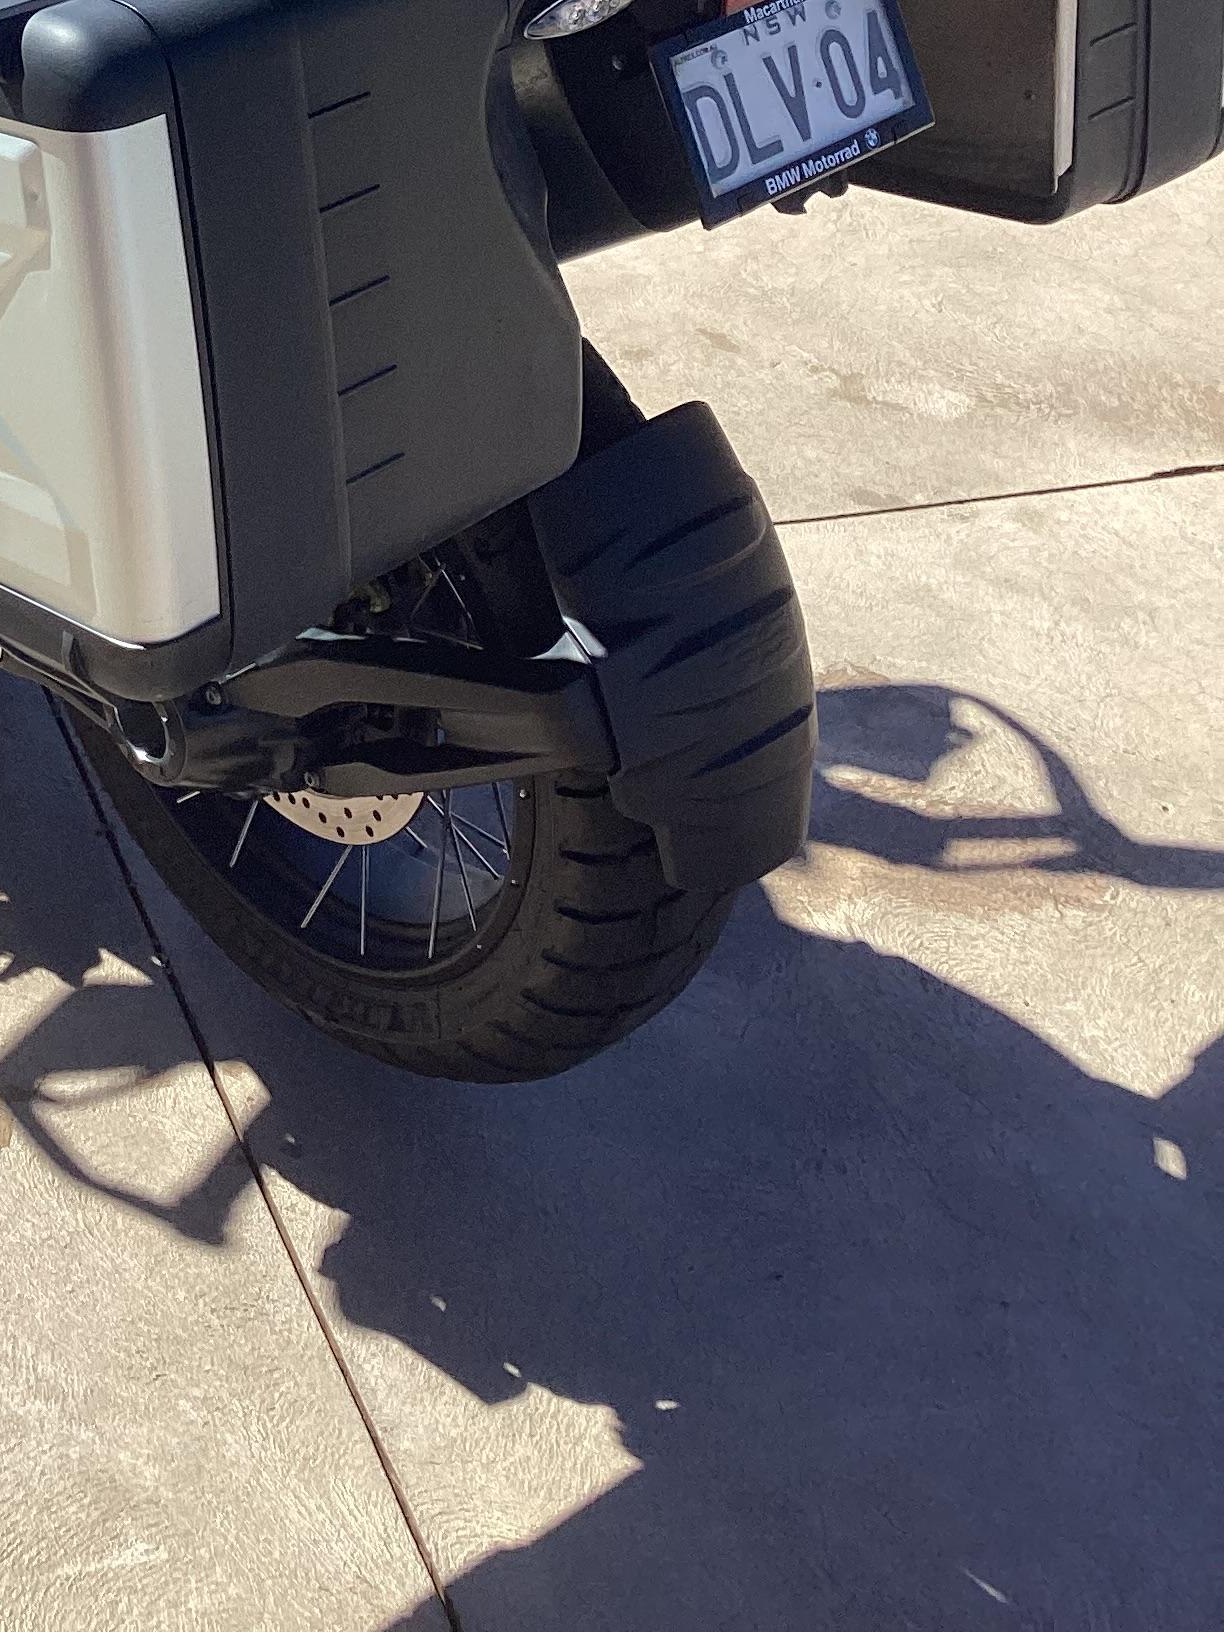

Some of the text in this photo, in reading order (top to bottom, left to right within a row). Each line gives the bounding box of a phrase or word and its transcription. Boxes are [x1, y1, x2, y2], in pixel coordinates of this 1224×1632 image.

[742, 4, 807, 47] NSW
[764, 139, 861, 196] BMW Motorrad
